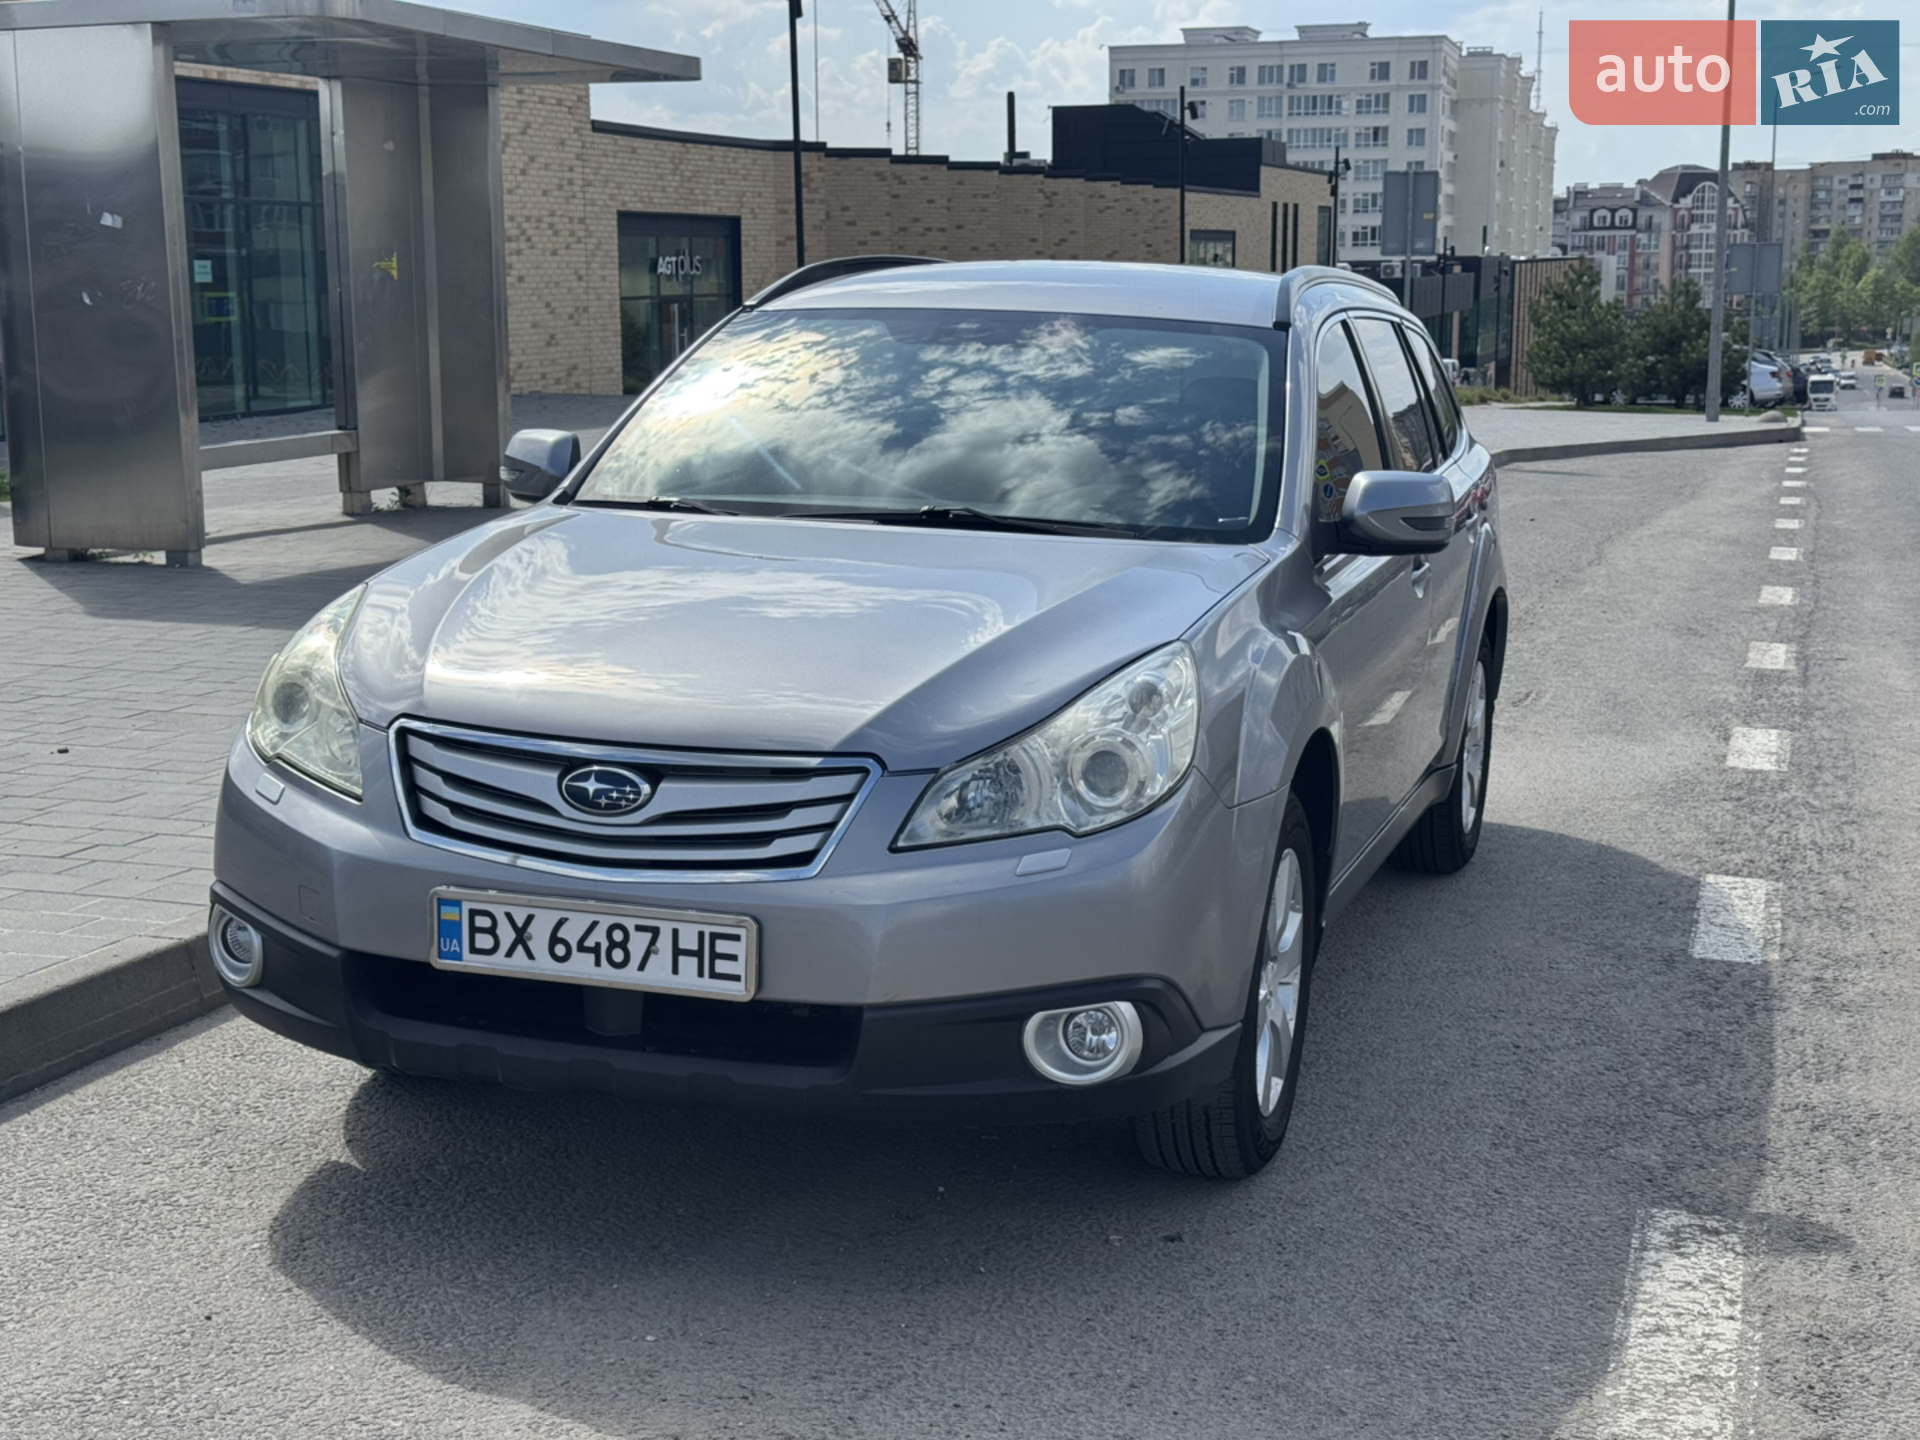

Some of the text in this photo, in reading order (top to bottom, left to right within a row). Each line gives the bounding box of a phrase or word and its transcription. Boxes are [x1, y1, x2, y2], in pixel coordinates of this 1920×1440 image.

[440, 937, 460, 953] UA
[468, 908, 742, 983] BX 6487 HE
